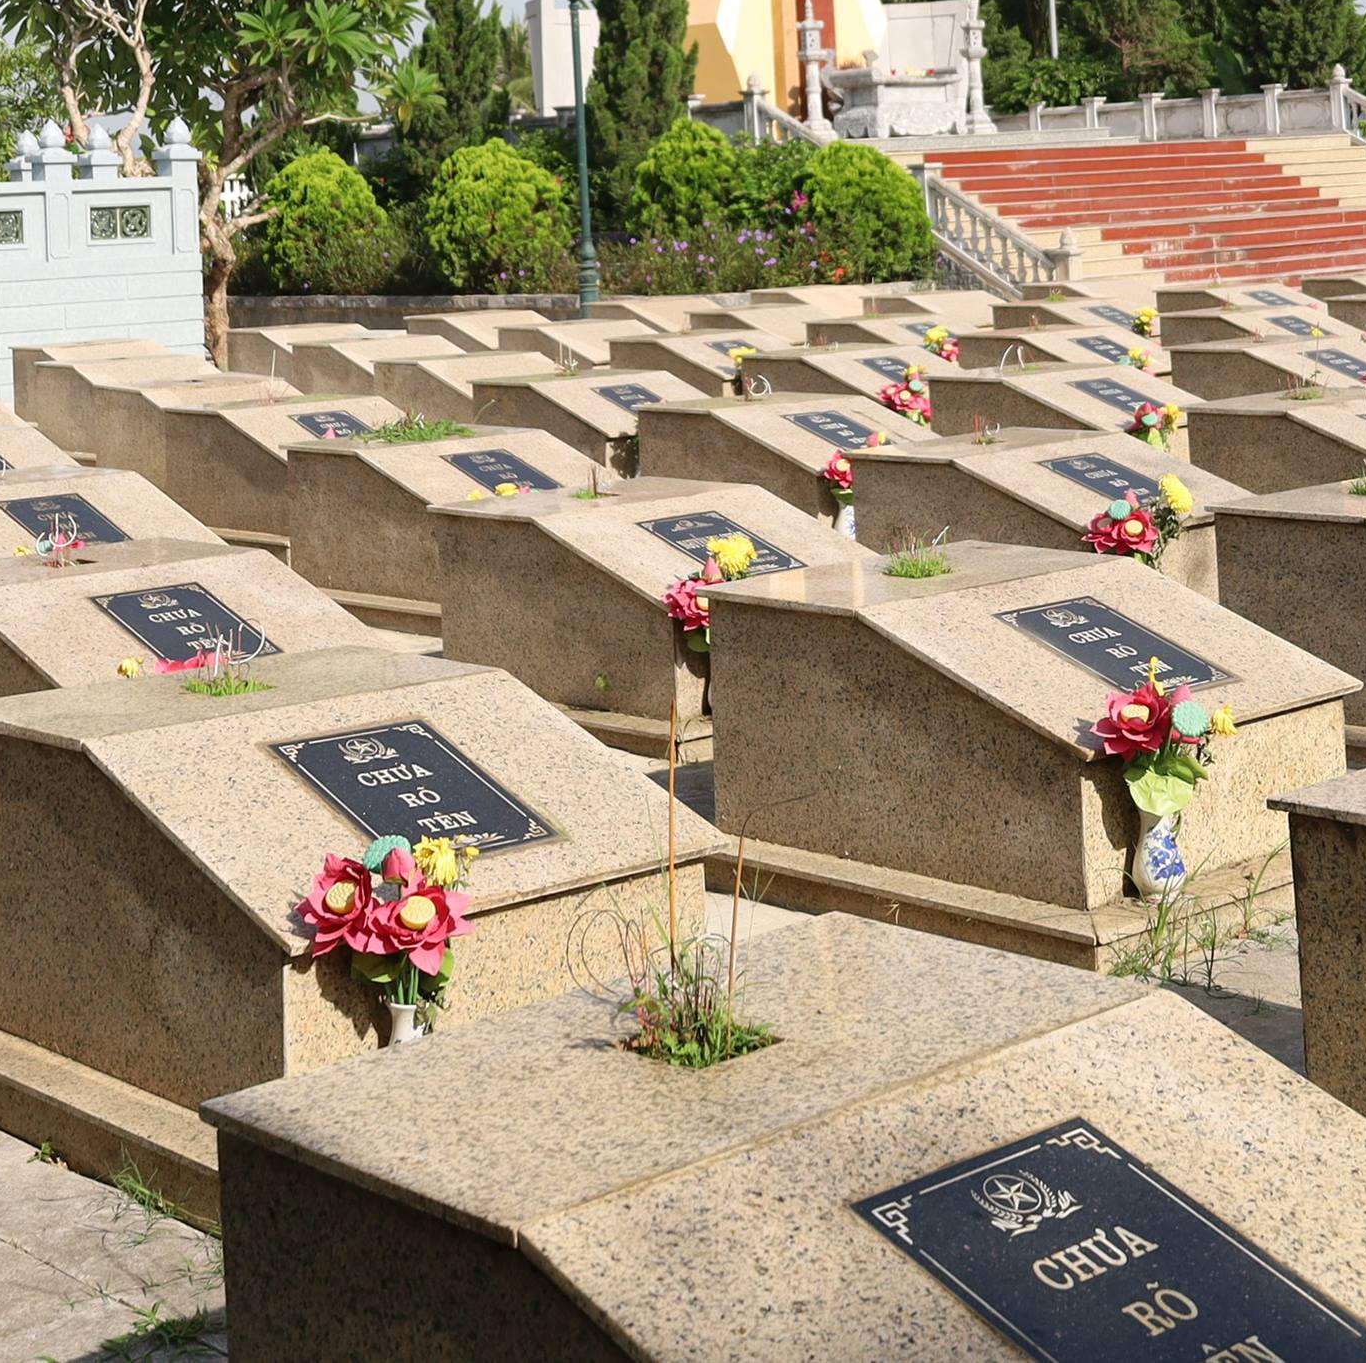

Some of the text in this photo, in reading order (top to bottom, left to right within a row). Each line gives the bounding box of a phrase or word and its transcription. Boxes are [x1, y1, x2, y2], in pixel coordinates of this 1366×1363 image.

[148, 607, 202, 623] CHƯA
[1068, 626, 1122, 644] CHƯA
[356, 762, 434, 788] CHƯA
[397, 786, 442, 809] RÕ
[416, 810, 479, 834] TÊN
[1032, 1226, 1159, 1290] CHƯA
[1121, 1281, 1199, 1337] RÕ
